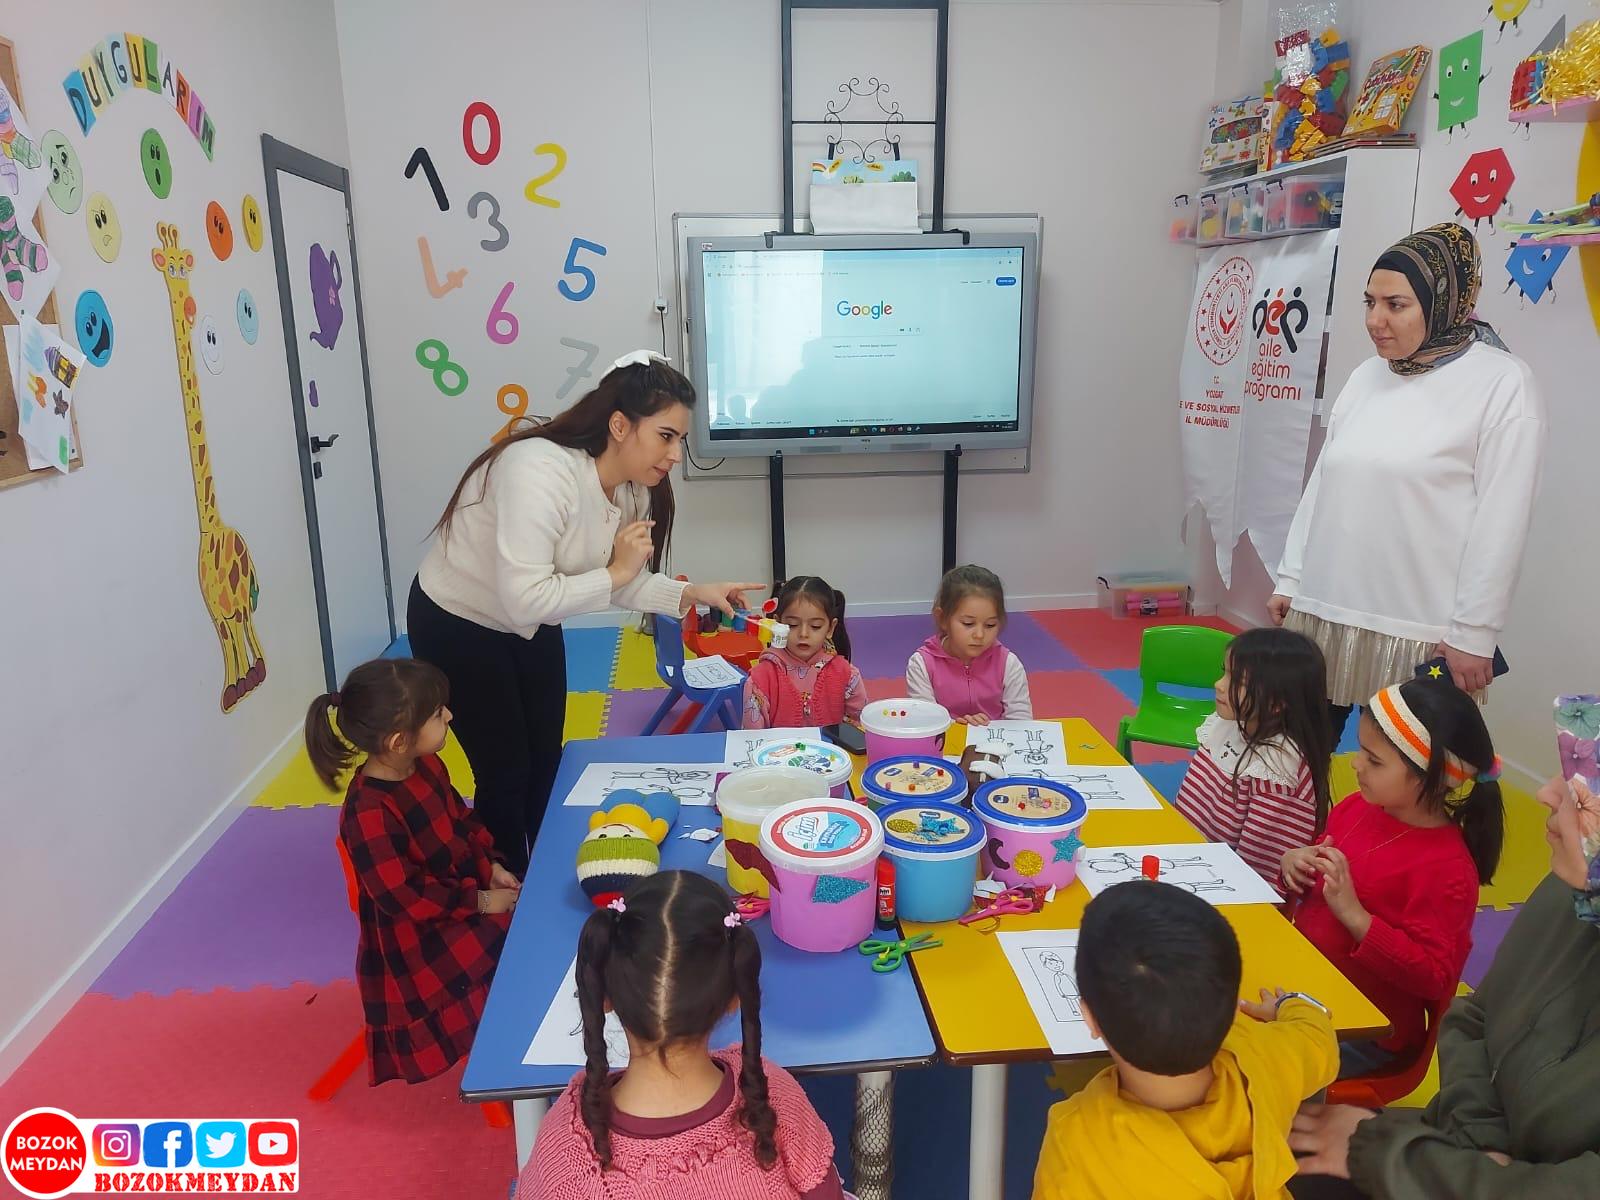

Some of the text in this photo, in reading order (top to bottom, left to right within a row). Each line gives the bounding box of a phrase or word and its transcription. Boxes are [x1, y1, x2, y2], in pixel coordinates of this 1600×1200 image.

[68, 40, 213, 154] DUYGULARIM
[462, 102, 501, 165] 0
[404, 147, 450, 211] 1
[524, 143, 567, 208] 2
[467, 191, 509, 252] 3
[557, 237, 607, 301] 5
[486, 281, 519, 345] 6
[836, 300, 893, 320] Google
[415, 339, 468, 397] 8
[555, 336, 599, 399] 7
[1252, 357, 1290, 381] eğitim
[1259, 339, 1282, 358] aile
[490, 384, 528, 444] 9
[1184, 401, 1195, 410] VE
[1244, 380, 1302, 402] programı
